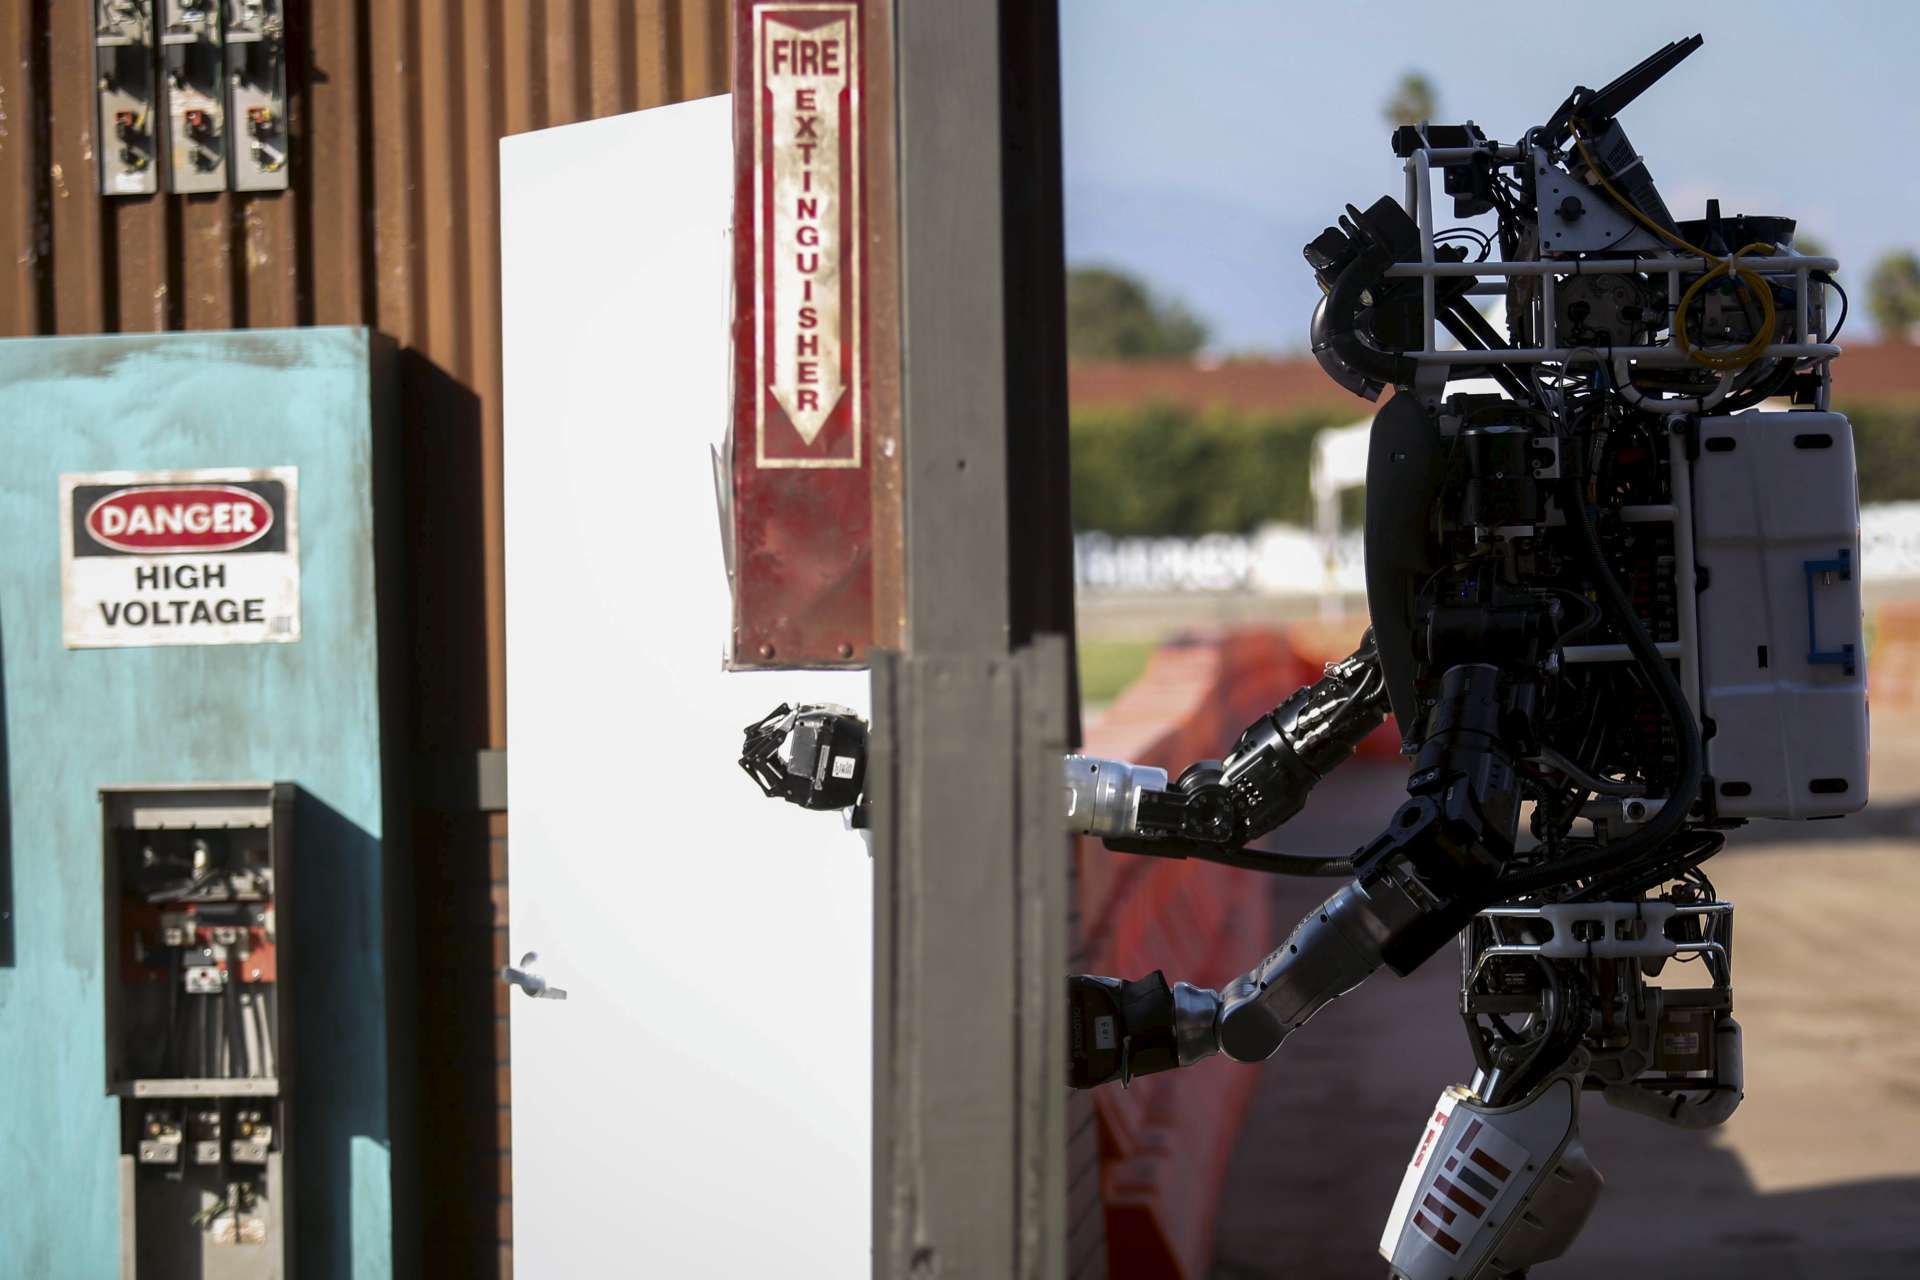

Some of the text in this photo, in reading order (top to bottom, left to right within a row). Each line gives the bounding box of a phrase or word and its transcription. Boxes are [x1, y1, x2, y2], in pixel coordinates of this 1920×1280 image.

[772, 39, 840, 76] FIRE
[794, 88, 820, 412] EXTINGUISHER
[101, 502, 256, 537] DANGER
[136, 563, 227, 590] HIGH
[99, 598, 265, 626] VOLTAGE
